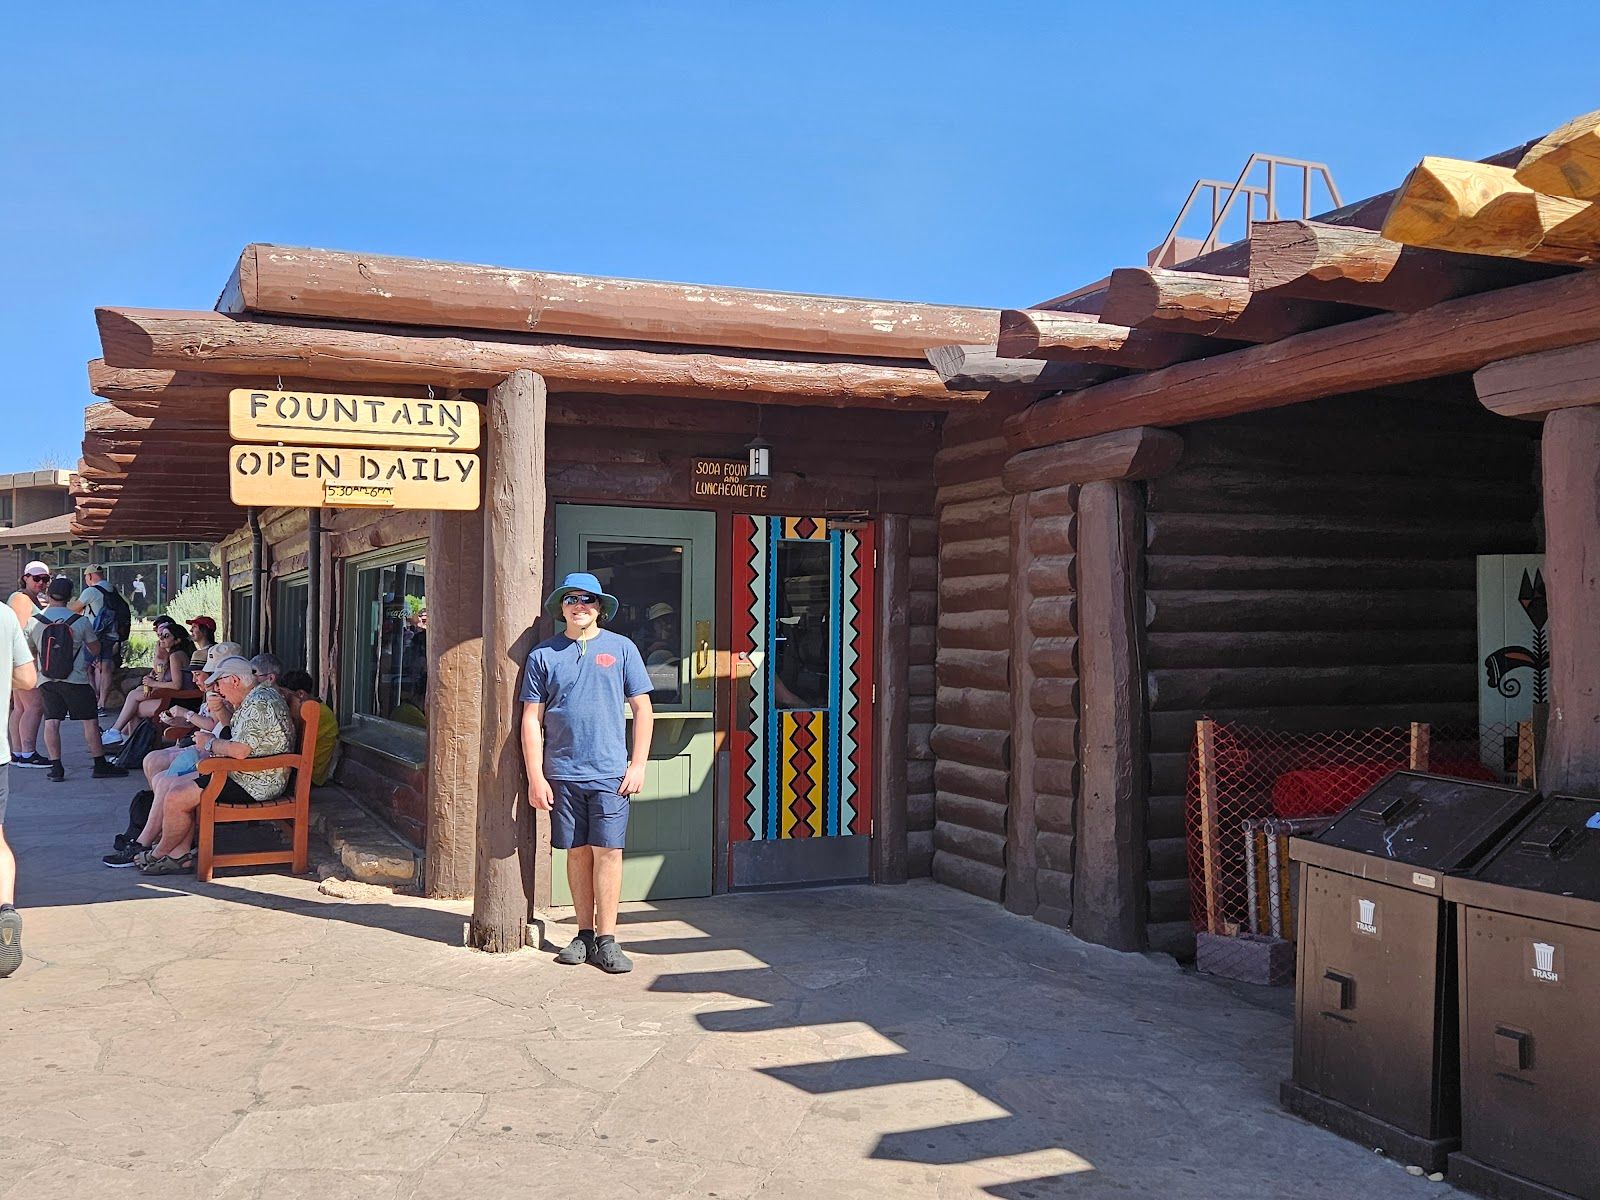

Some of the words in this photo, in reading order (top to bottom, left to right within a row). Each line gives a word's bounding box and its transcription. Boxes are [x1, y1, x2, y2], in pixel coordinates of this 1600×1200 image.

[250, 393, 462, 427] FOUNTAIN
[235, 451, 340, 479] OPEN
[360, 455, 474, 482] DAILY
[695, 461, 720, 475] SODA
[723, 463, 749, 476] FOUN
[695, 481, 767, 497] LUNCHEONETTE
[1355, 921, 1377, 934] TRASH
[1531, 968, 1558, 982] TRASH
